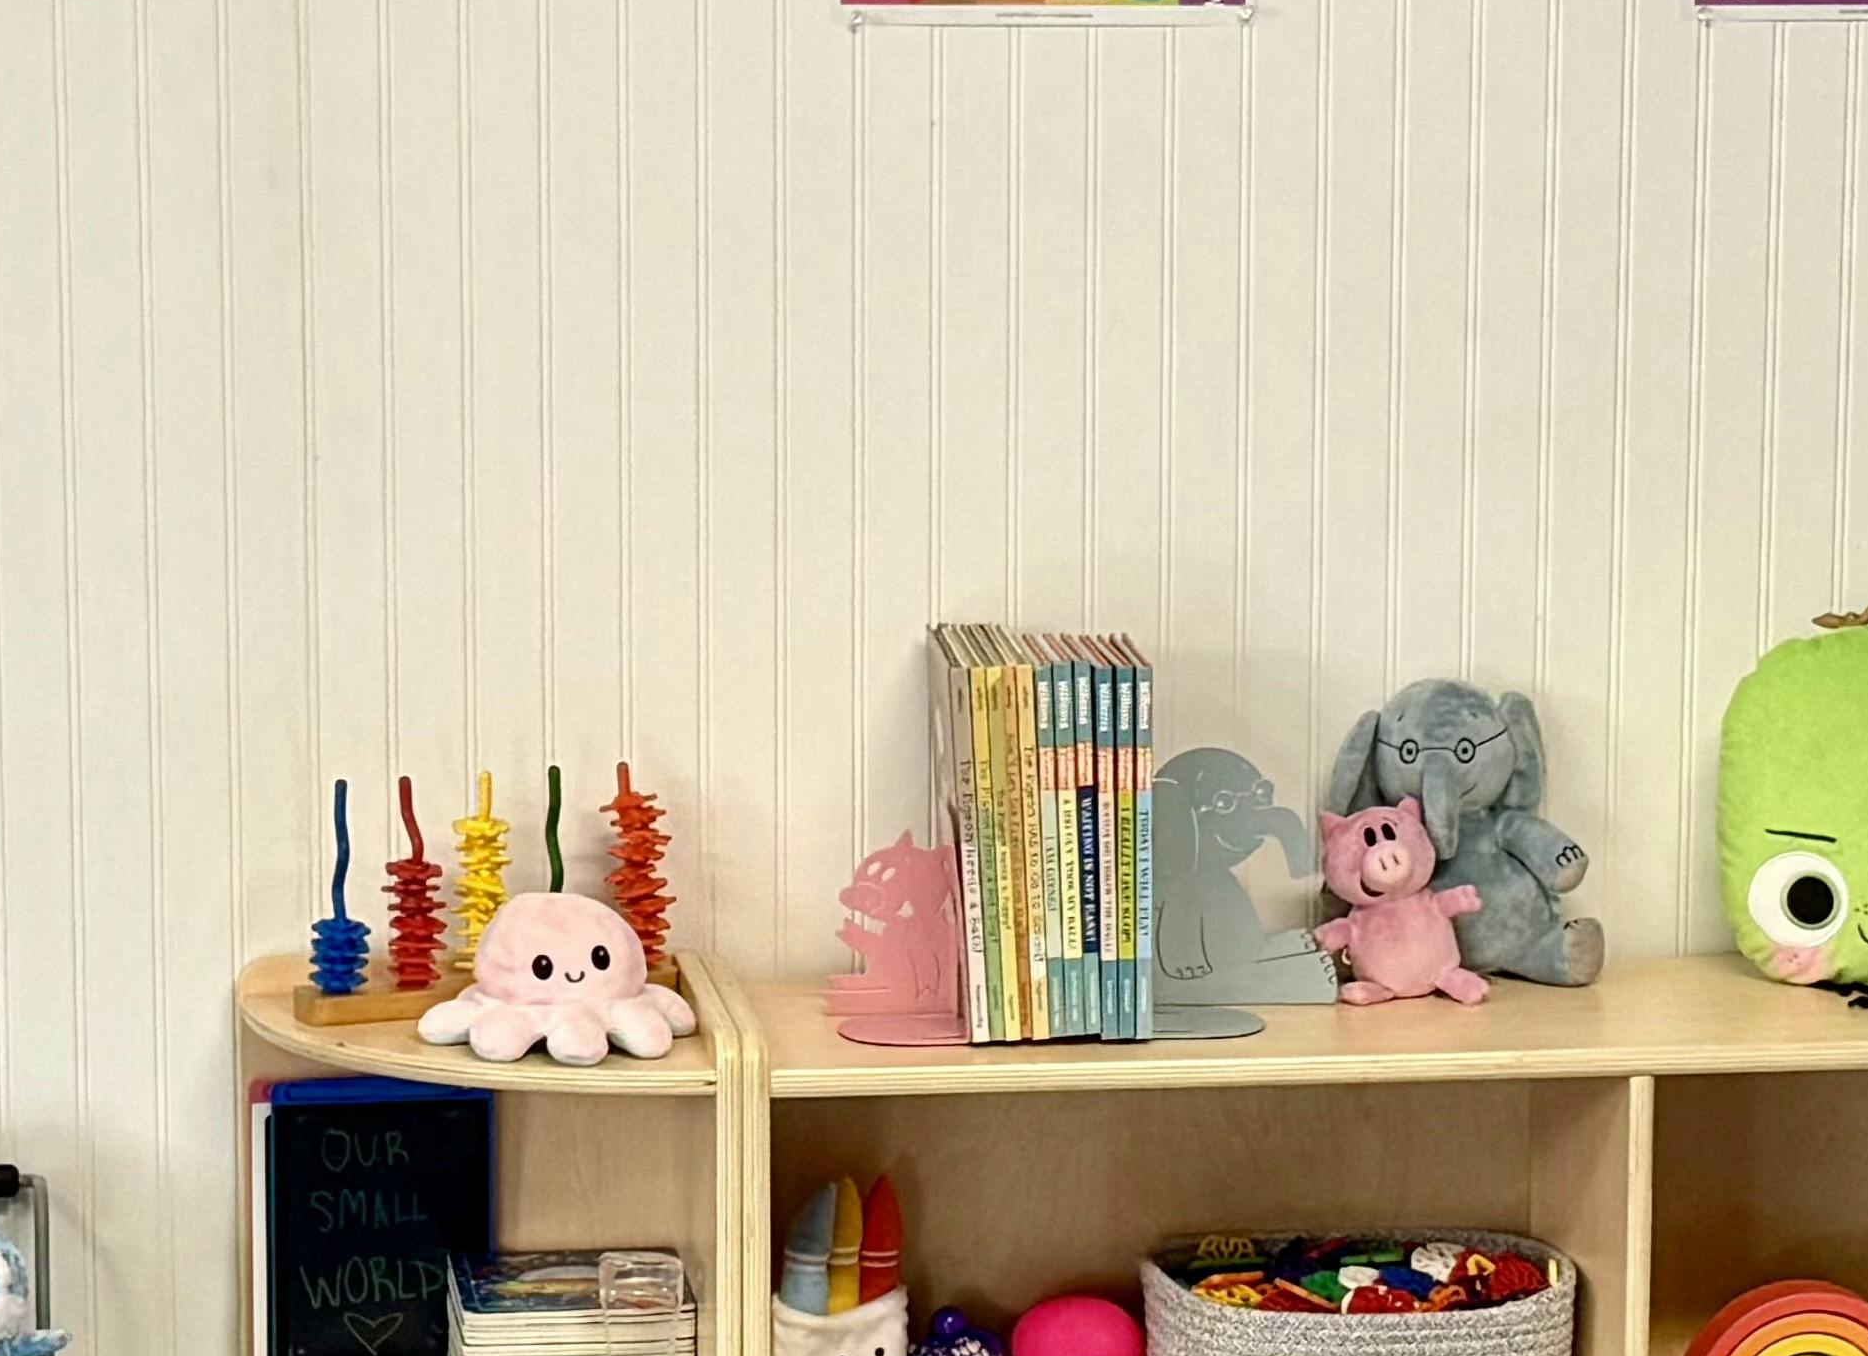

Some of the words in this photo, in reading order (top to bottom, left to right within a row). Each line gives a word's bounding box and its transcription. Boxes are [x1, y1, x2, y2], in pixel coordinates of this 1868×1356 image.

[320, 1129, 411, 1172] OUR
[309, 1188, 428, 1233] SMALL
[299, 1255, 445, 1309] WORLD
